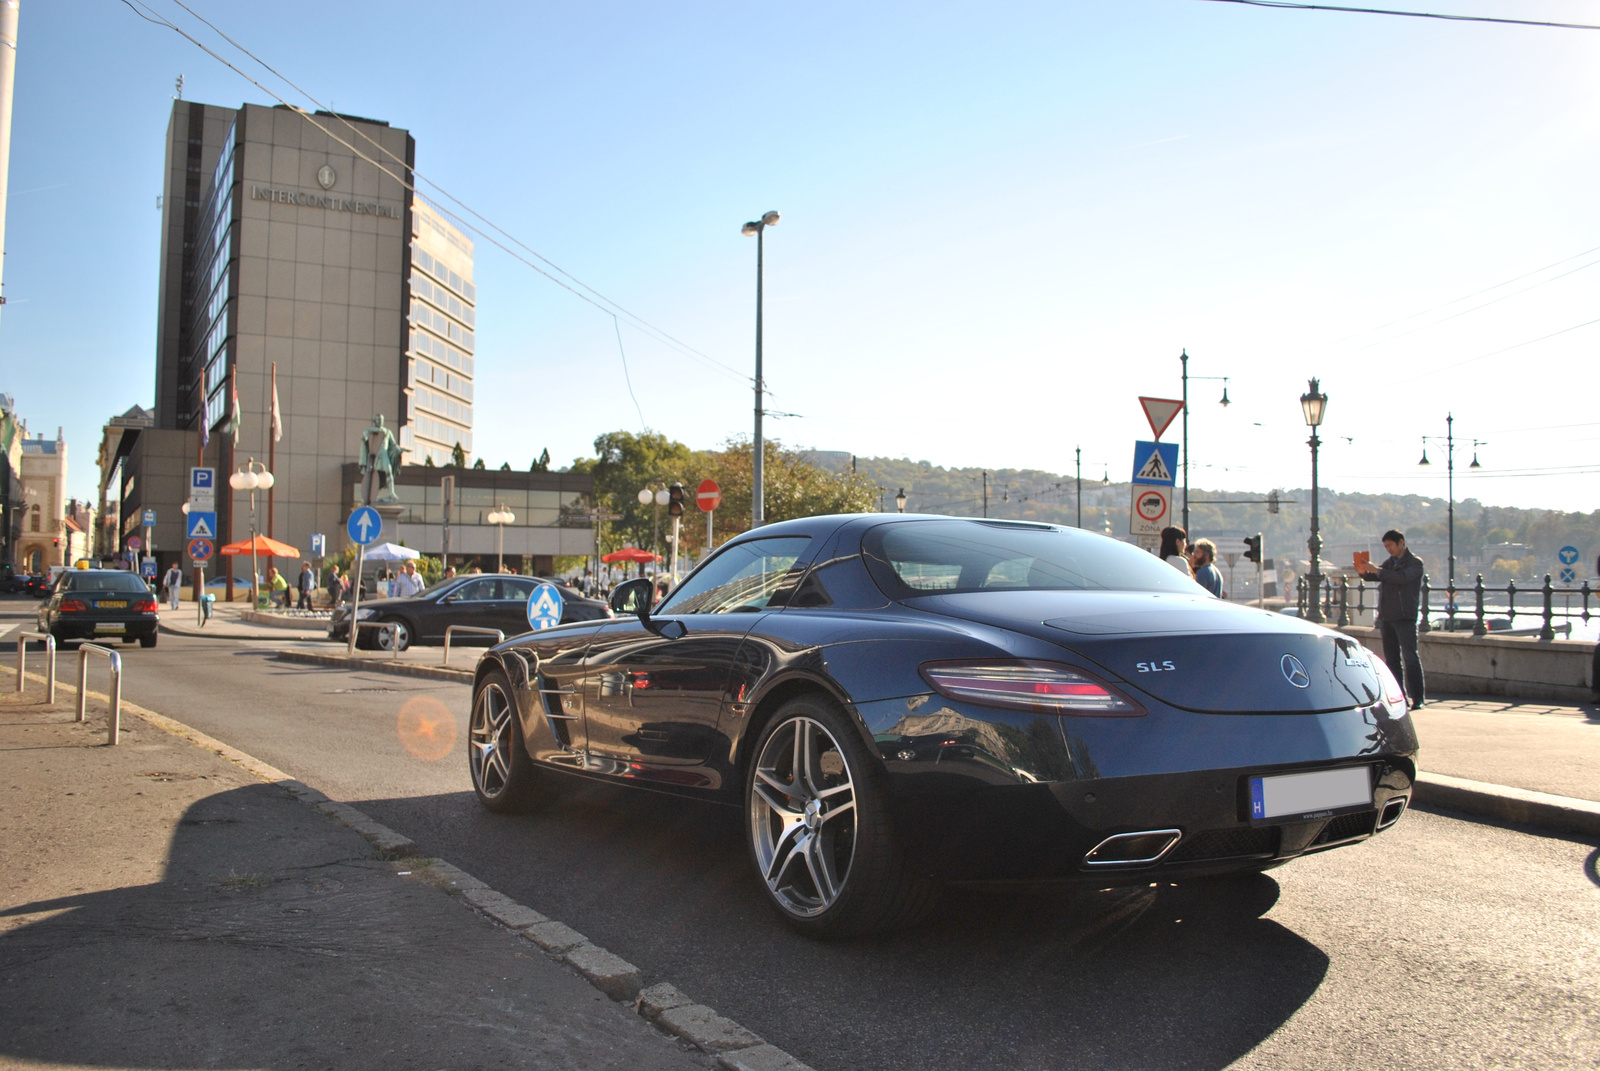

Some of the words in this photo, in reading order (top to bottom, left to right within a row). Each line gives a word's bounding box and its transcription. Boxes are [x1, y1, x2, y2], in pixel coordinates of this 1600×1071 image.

[252, 185, 399, 219] INTERCONTINENTAL
[197, 472, 208, 485] P
[312, 536, 320, 551] P
[1136, 660, 1175, 673] SLS
[1254, 801, 1261, 813] H
